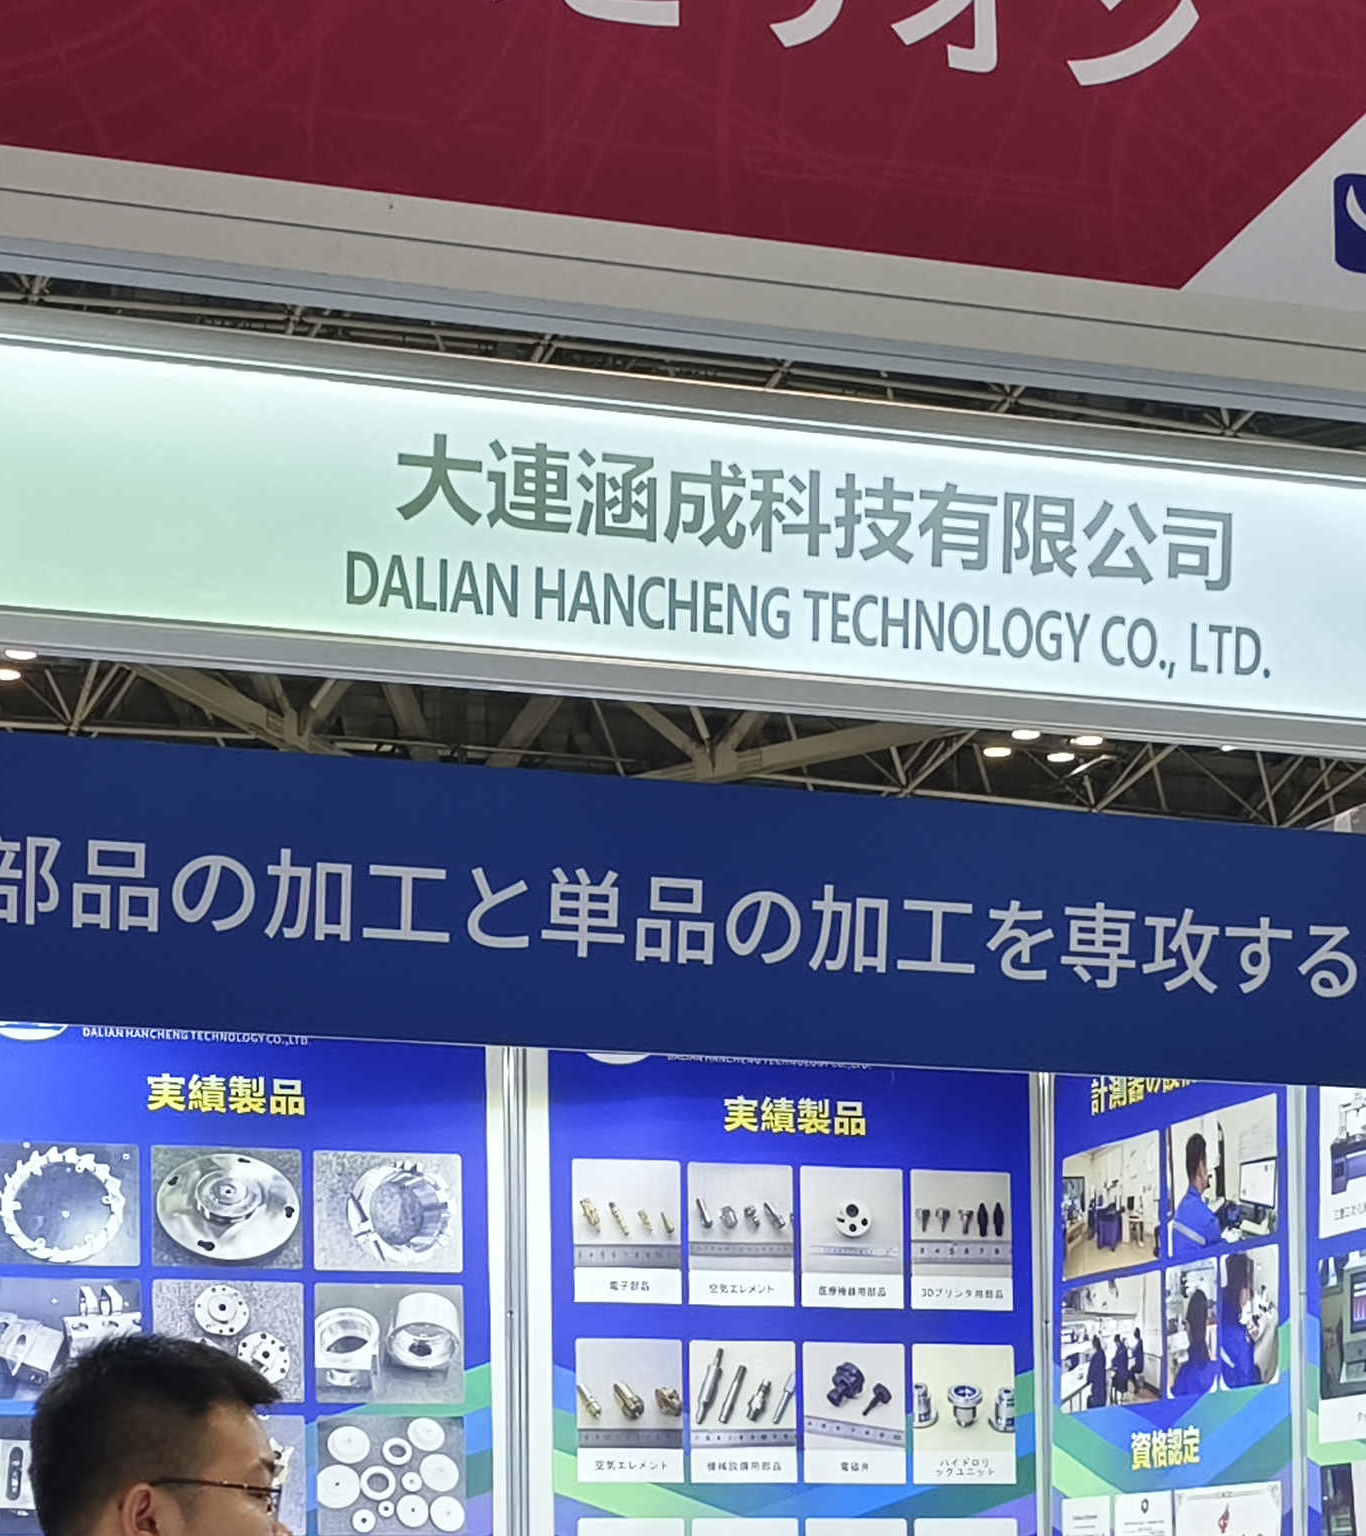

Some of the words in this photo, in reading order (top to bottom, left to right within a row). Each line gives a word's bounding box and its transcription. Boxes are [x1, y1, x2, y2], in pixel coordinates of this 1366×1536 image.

[397, 432, 1236, 592] 大連涵成科技有限公司
[343, 548, 519, 621] DALIAN
[534, 565, 792, 643] HANCHENG
[803, 587, 1091, 666] TECHNOLOGY
[1099, 612, 1179, 680] CO.,
[1187, 621, 1271, 682] LTD.
[147, 1072, 306, 1116] 実績製品
[724, 1095, 867, 1137] 実績製品
[609, 1280, 650, 1292] 電子部品
[708, 1282, 775, 1296] 空気エレメント
[1131, 1425, 1200, 1470] 資格認定
